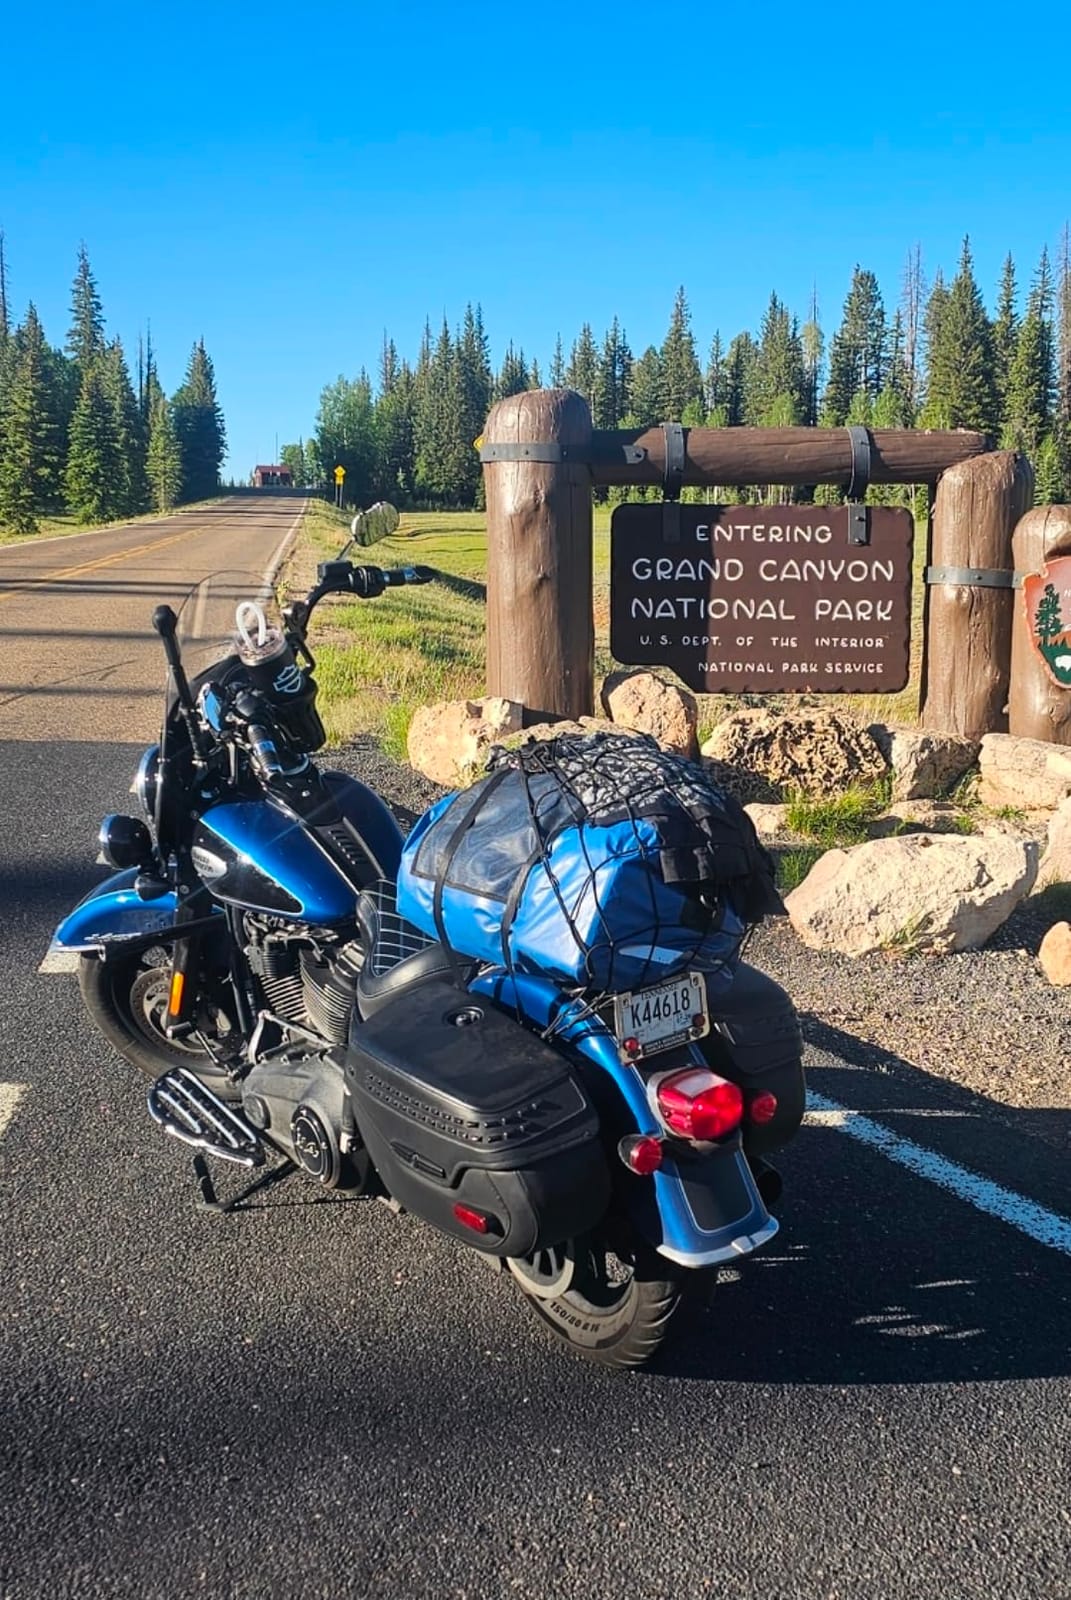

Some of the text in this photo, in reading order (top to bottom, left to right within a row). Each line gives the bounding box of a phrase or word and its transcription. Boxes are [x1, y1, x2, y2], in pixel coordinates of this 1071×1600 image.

[696, 525, 833, 544] ENTERING
[632, 558, 894, 582] GRAND CANYON
[631, 598, 893, 621] NATIONAL PARK
[640, 635, 885, 648] U. S. DEPT. OF THE INTERIOR
[699, 662, 884, 674] NATIONAL PARK SERVICE
[631, 988, 691, 1029] K44618
